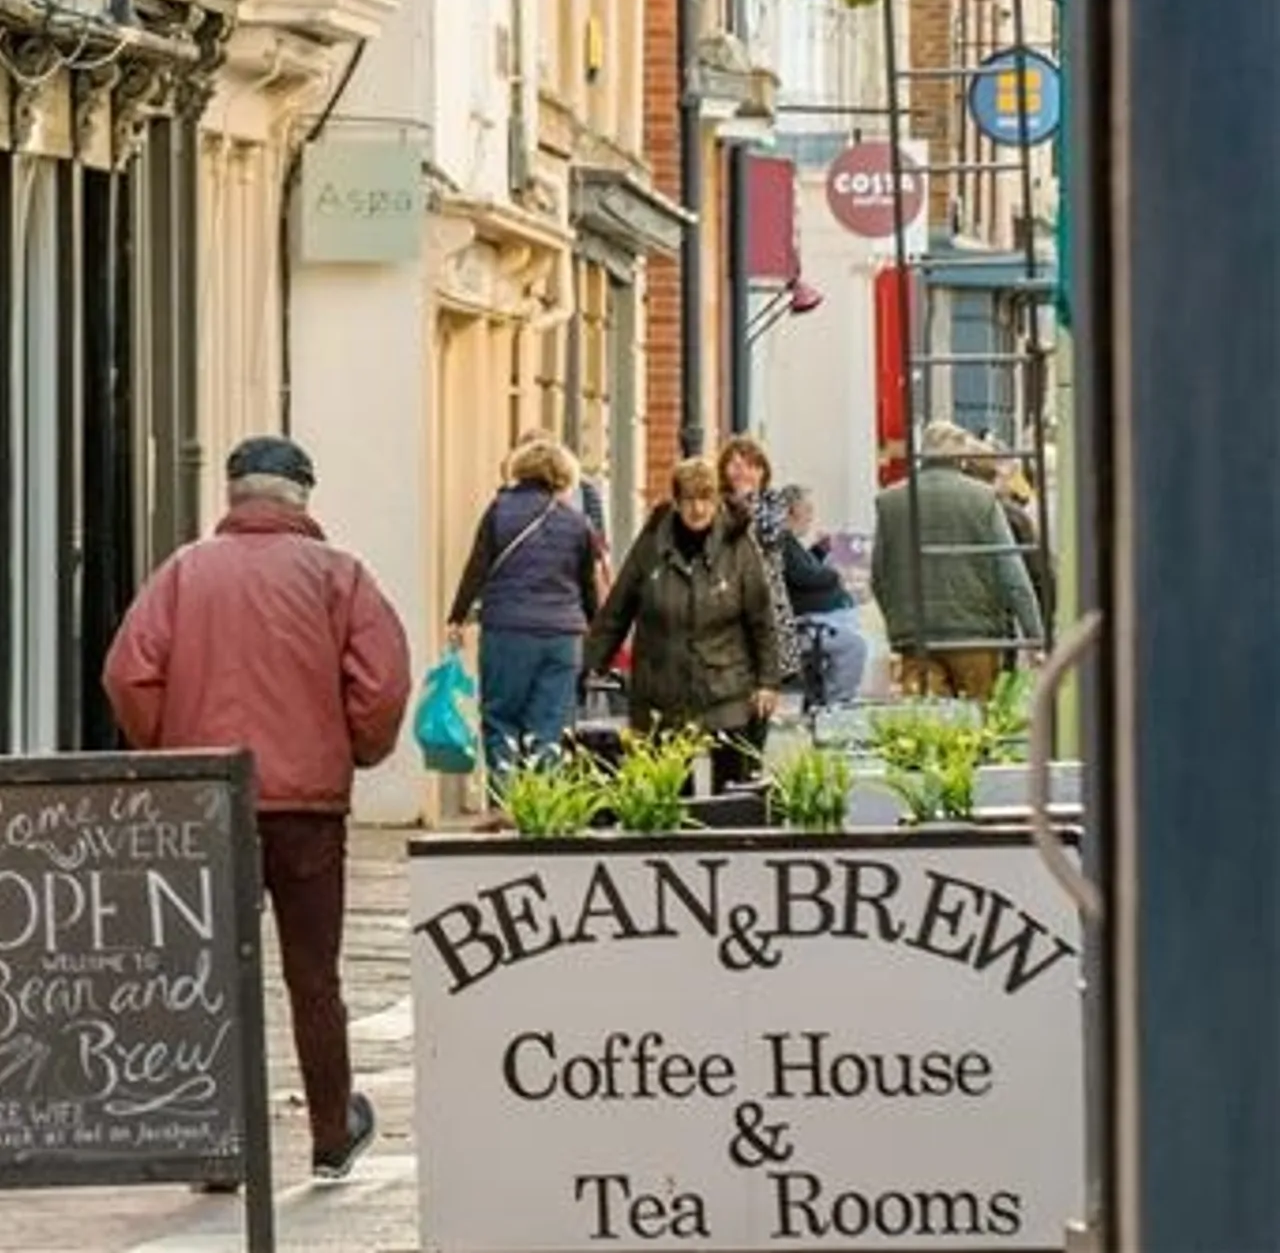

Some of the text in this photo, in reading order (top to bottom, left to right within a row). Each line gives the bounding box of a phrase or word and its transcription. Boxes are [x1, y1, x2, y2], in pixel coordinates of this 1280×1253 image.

[109, 787, 160, 822] in
[412, 858, 1080, 996] BEAN & BREW
[109, 949, 225, 1015] and
[60, 1019, 232, 1099] Brew
[502, 1032, 993, 1101] Coffee House
[727, 1102, 795, 1168] &
[574, 1171, 1022, 1240] Tea Rooms
